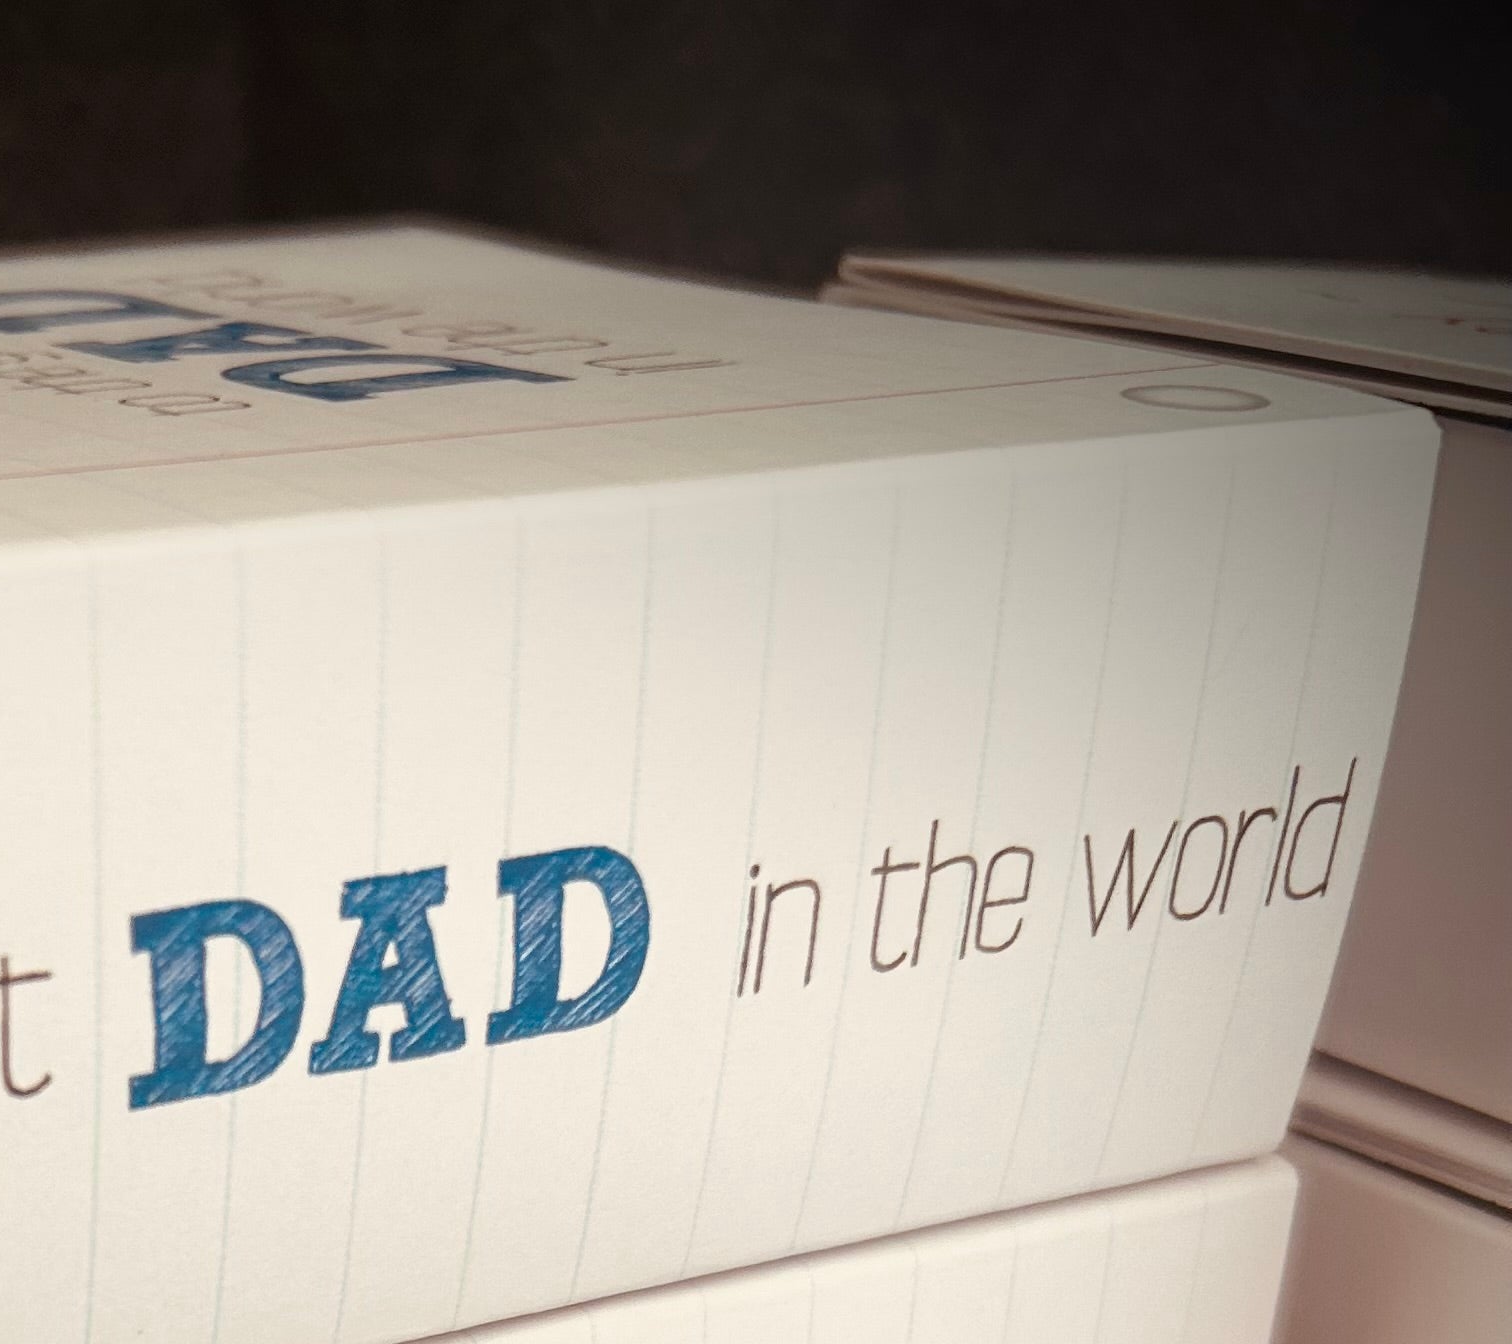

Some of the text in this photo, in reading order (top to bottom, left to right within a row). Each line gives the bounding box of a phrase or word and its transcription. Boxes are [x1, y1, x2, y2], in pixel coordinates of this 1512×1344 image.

[128, 844, 650, 1110] DAD
[736, 862, 821, 998] in
[869, 820, 1035, 974] the
[1084, 756, 1358, 939] world
